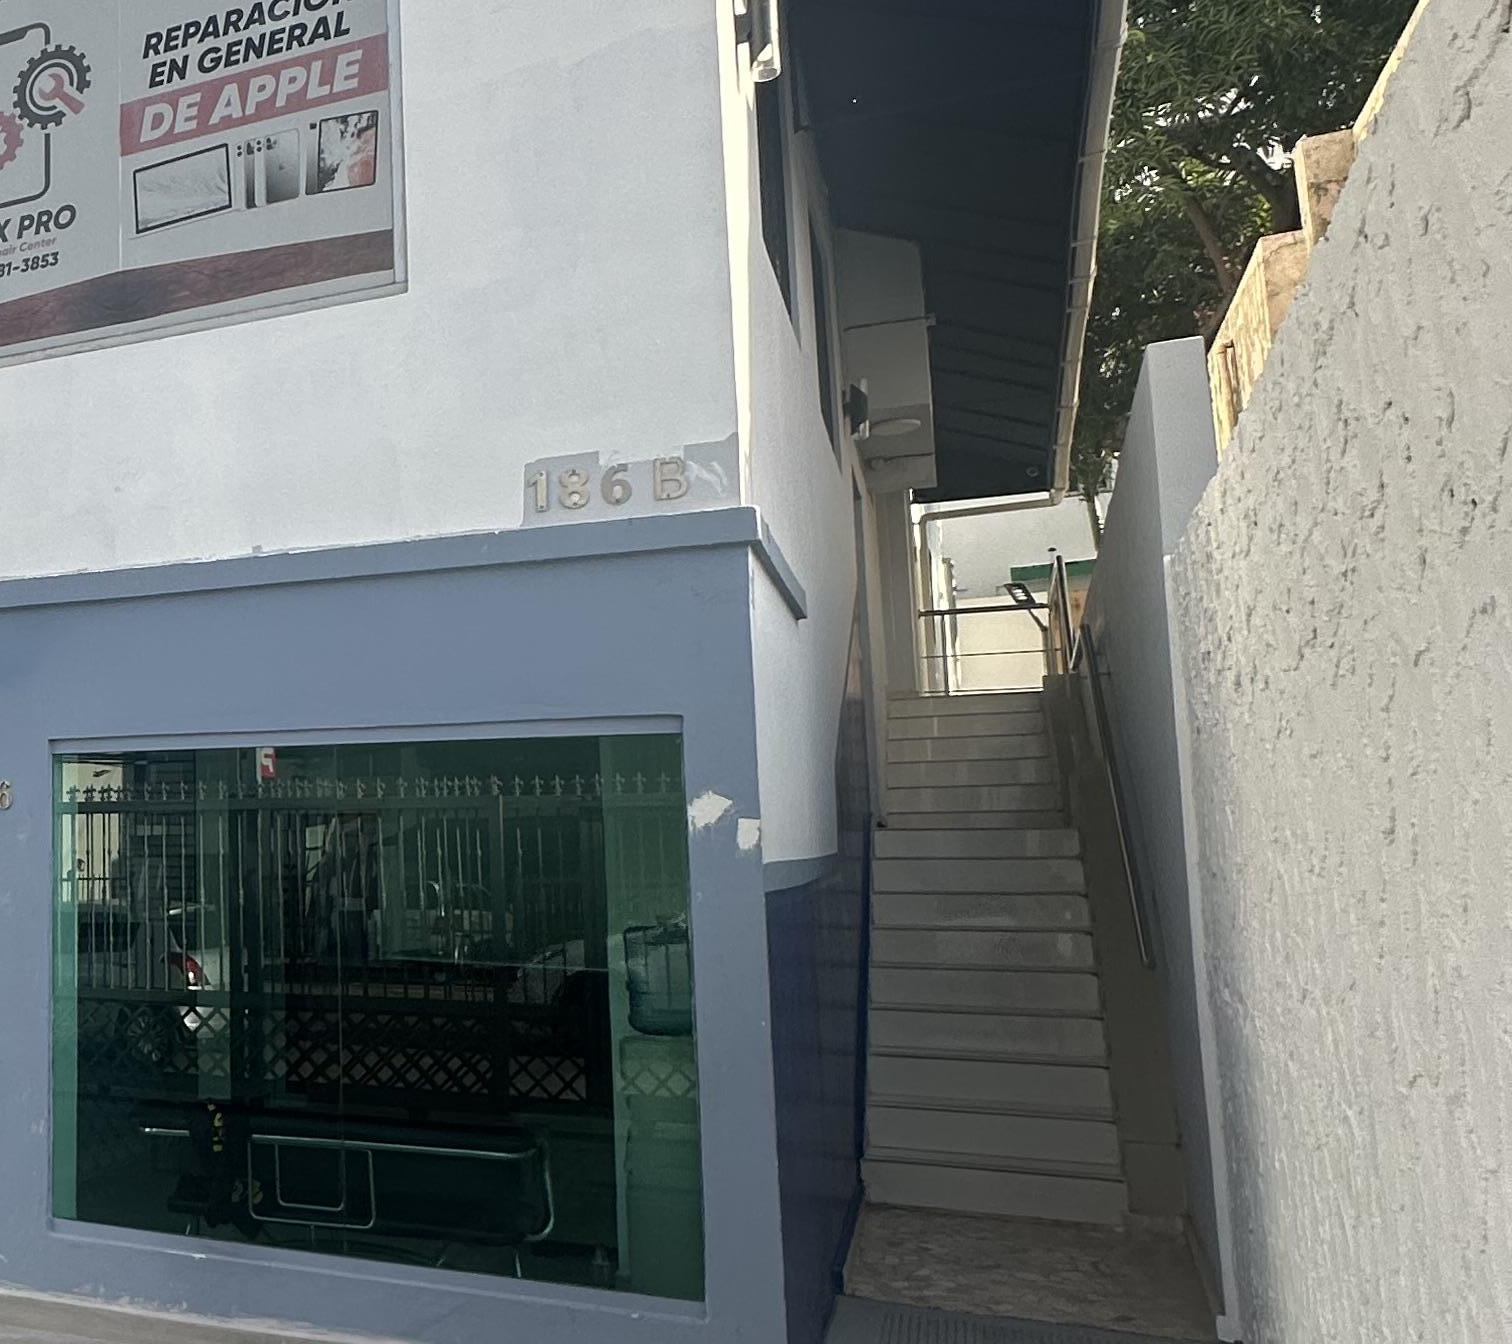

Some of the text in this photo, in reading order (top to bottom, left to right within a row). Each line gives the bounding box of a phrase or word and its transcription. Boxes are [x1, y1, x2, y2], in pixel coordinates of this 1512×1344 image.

[148, 11, 351, 89] EN GENERAL
[139, 49, 363, 143] DE APPLE
[16, 204, 77, 240] PRO
[19, 236, 57, 253] Center
[527, 456, 689, 513] 186 B
